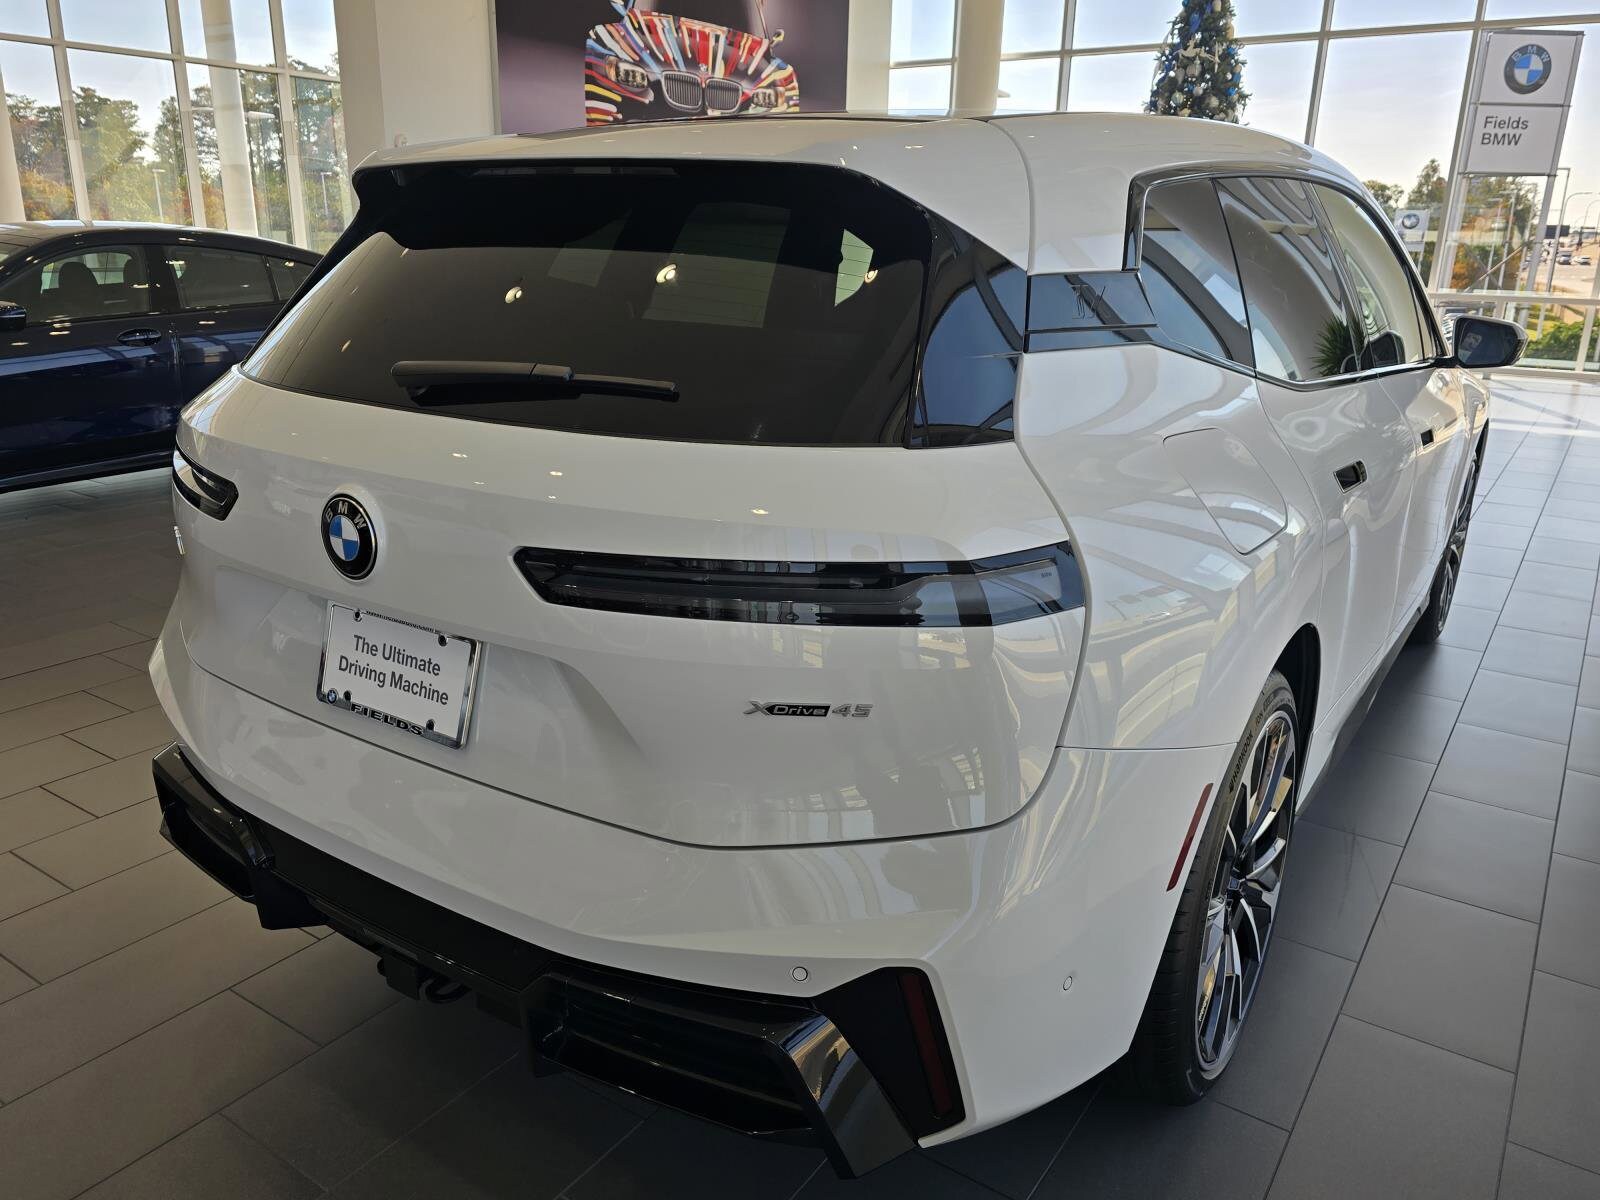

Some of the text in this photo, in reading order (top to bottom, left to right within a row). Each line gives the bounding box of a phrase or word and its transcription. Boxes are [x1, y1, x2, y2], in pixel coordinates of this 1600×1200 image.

[1511, 46, 1550, 63] BMW
[1483, 116, 1528, 130] Fields
[1481, 132, 1522, 146] BMW
[325, 501, 367, 529] BMW
[353, 634, 441, 676] The Ultimate
[338, 655, 449, 706] Driving Machine
[351, 702, 424, 736] FIELDS
[832, 703, 873, 717] 45
